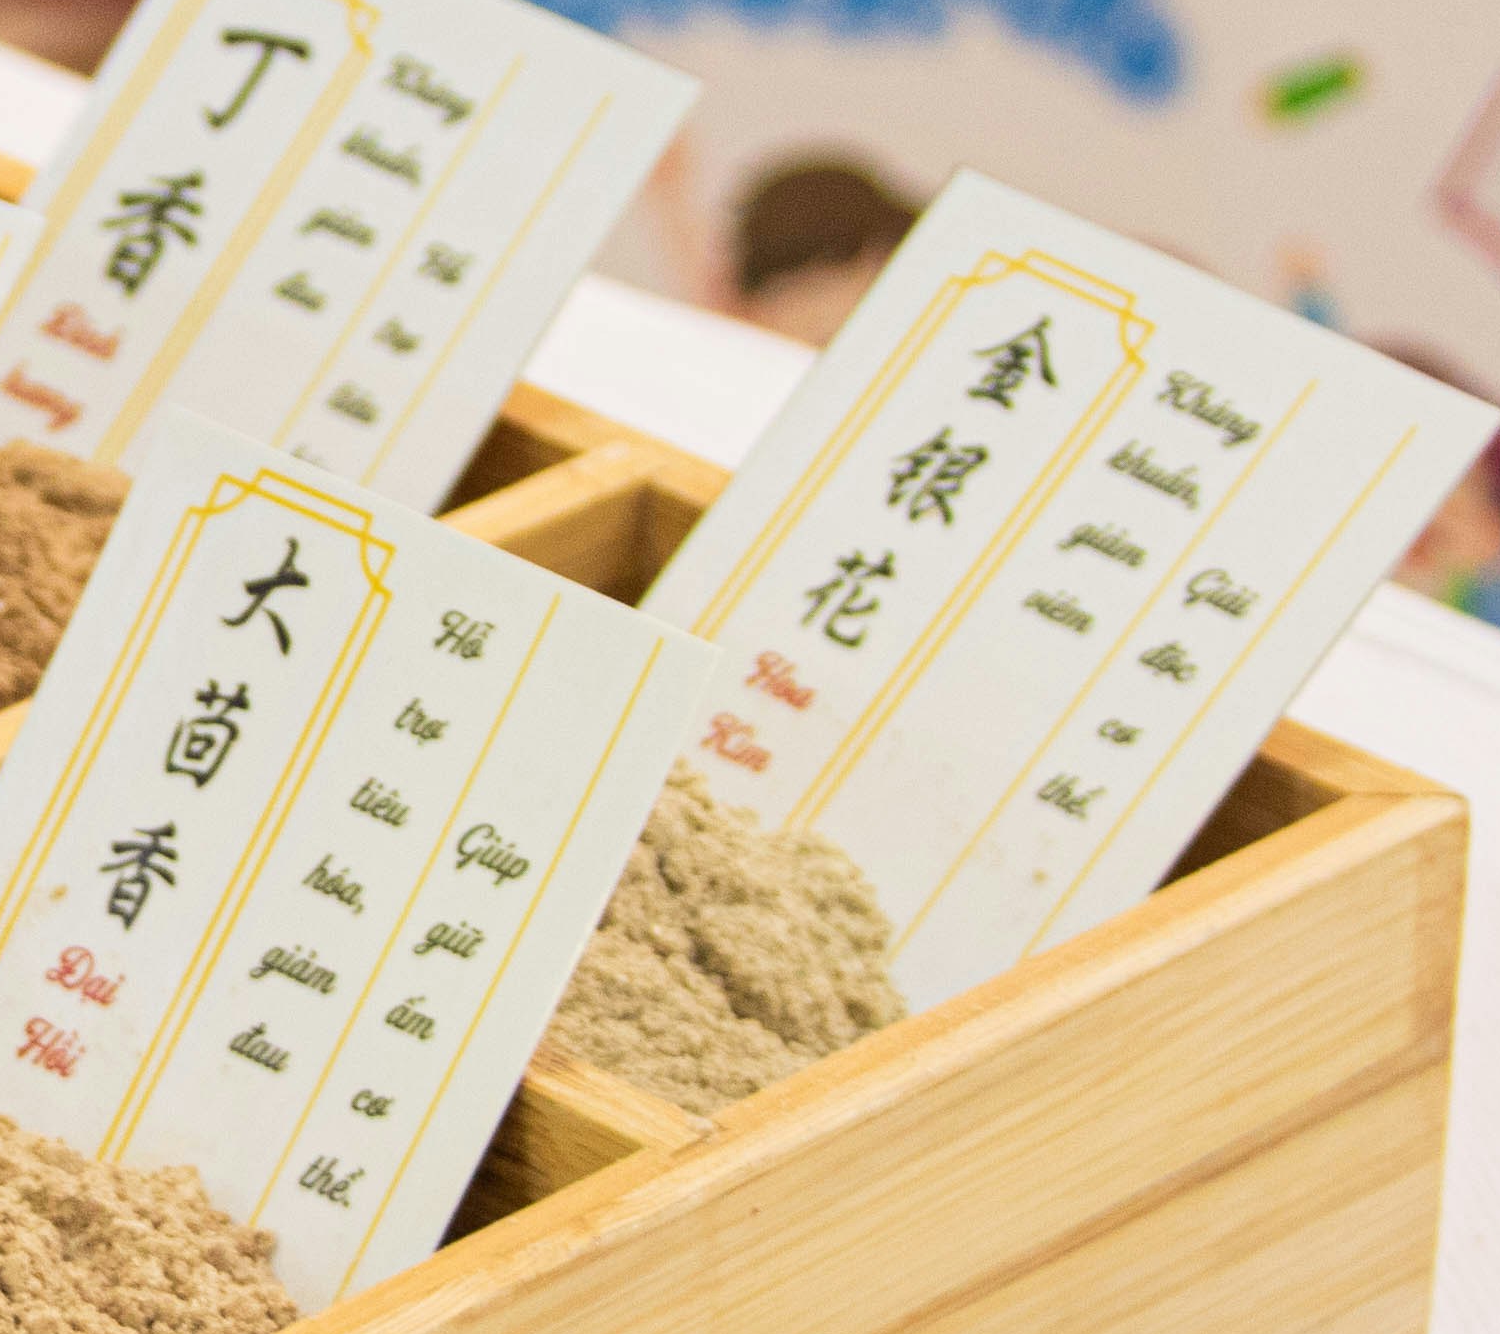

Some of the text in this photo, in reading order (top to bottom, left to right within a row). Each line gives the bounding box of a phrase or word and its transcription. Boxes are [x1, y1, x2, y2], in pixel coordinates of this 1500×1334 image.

[97, 21, 316, 302] 丁香
[801, 315, 1065, 650] 金银花
[1022, 371, 1261, 636] Kháng khuẩn, giảm viêm
[1182, 568, 1257, 620] Giải
[94, 534, 317, 931] 大茴香
[694, 651, 816, 779] Hoa Kim
[1097, 719, 1141, 746] cơ
[1137, 642, 1196, 684] độc
[228, 609, 495, 1074] Hỗ trợ tiêu hóa, giảm đau
[15, 945, 126, 1080] Đại Hồi
[297, 823, 530, 1208] Giúp giữ ấm cơ thể.
